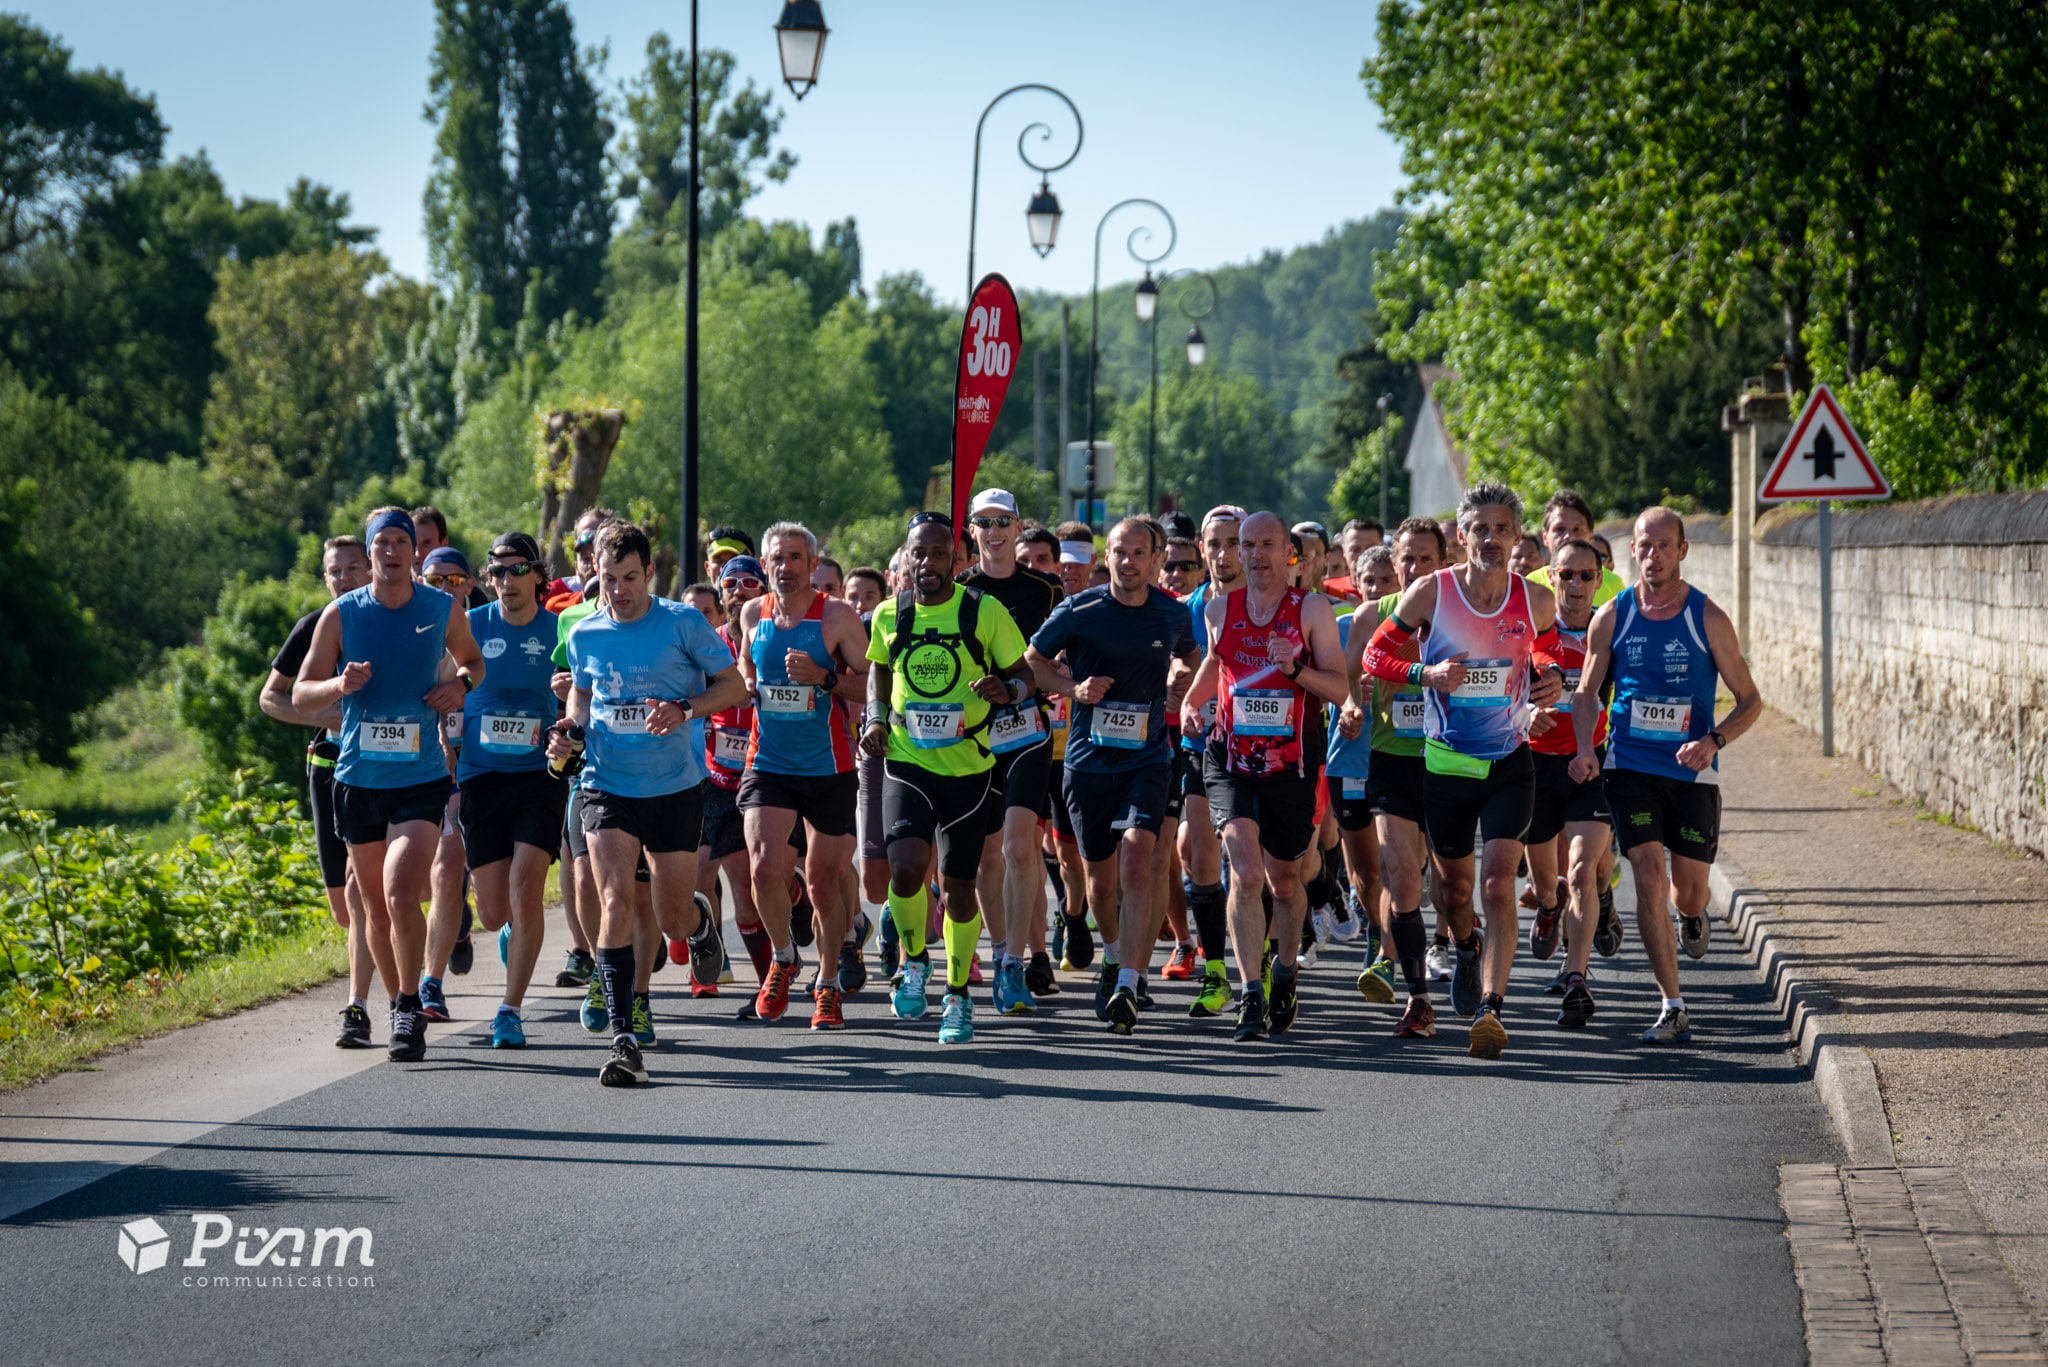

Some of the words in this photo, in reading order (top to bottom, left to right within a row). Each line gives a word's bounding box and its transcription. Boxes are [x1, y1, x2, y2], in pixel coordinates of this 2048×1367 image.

[1234, 651, 1275, 667] SAVEN
[1463, 671, 1497, 684] 5855
[769, 688, 800, 702] 7652
[1245, 699, 1279, 714] 5866
[1403, 704, 1425, 717] 609
[1642, 706, 1675, 720] 7014
[613, 708, 646, 721] 7871
[916, 714, 949, 727] 7927
[1103, 712, 1135, 727] 7425
[371, 726, 405, 739] 7394
[492, 720, 525, 734] 8072
[725, 737, 750, 751] 727
